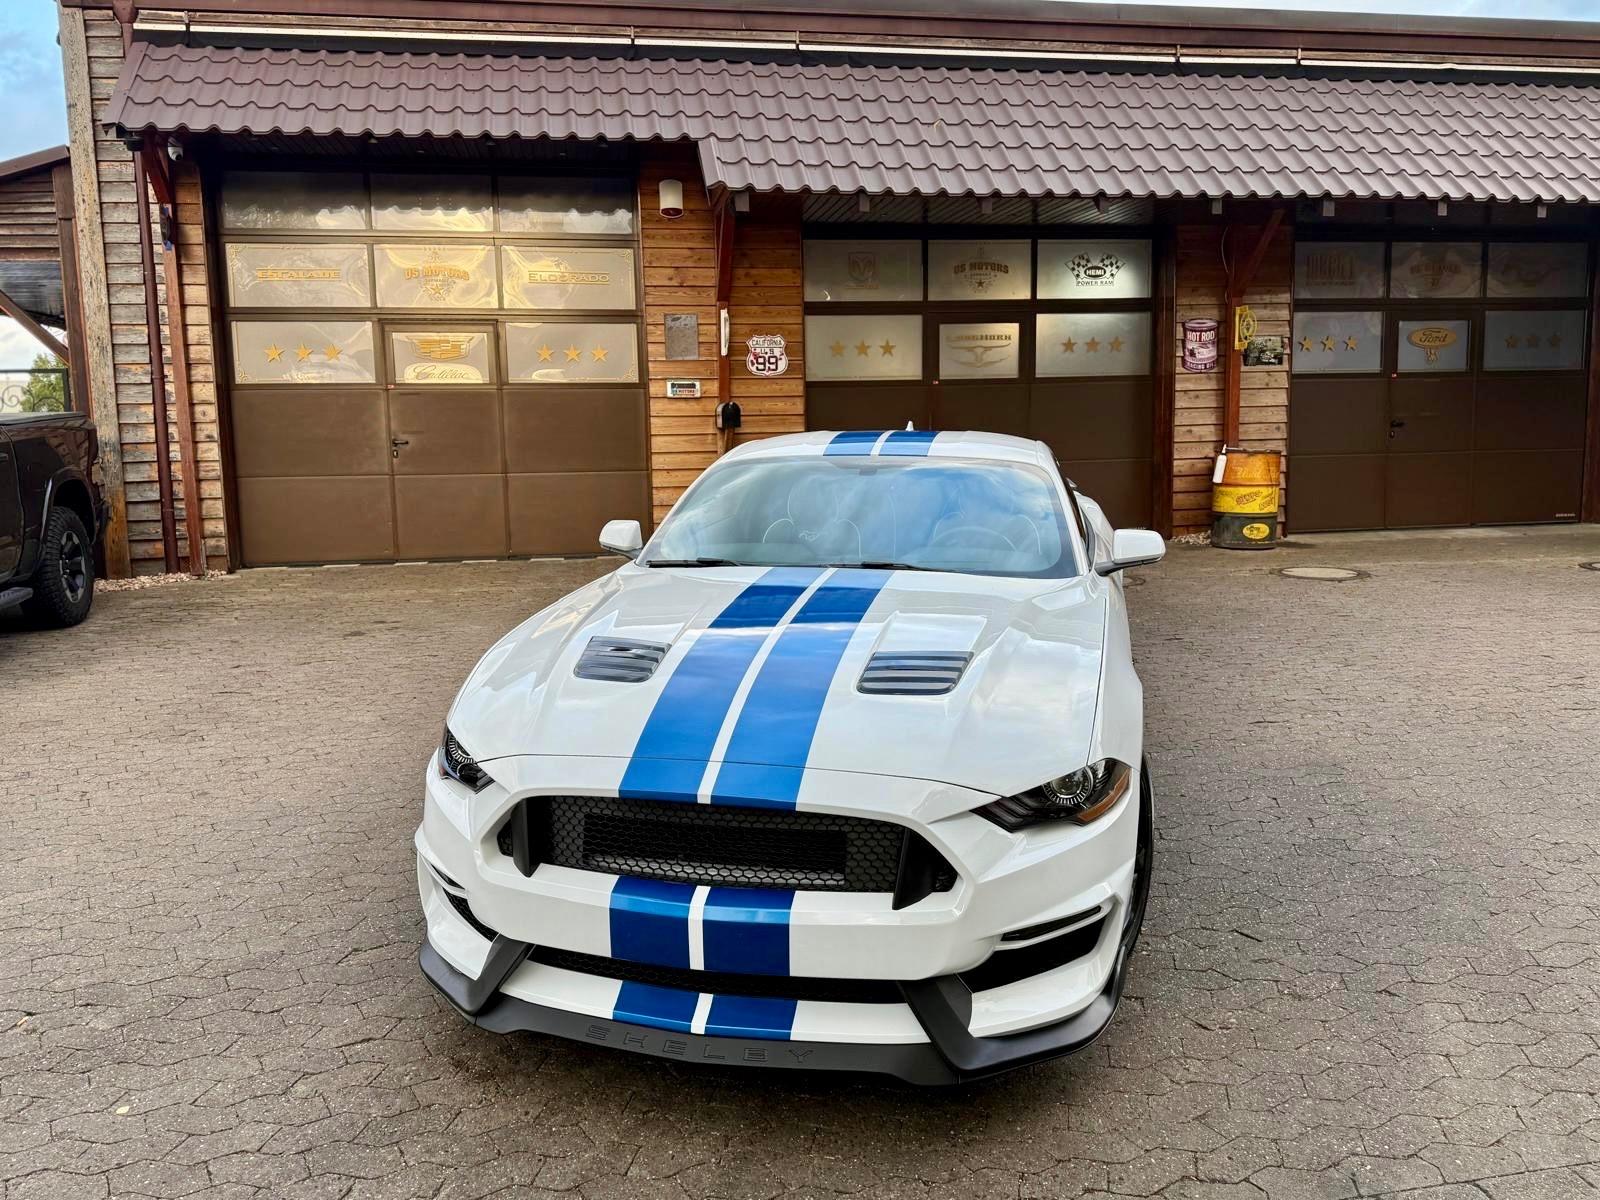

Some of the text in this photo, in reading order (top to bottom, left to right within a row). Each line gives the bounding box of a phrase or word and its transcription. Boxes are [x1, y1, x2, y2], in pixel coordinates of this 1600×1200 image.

[405, 267, 419, 280] US
[953, 261, 1009, 275] US MOTORS
[528, 272, 609, 283] ELDORADO
[1187, 330, 1215, 342] HOT ROD
[1419, 330, 1449, 344] Ford
[756, 355, 778, 372] 99
[413, 365, 469, 380] Cadillac
[585, 1023, 814, 1064] SHELBY
